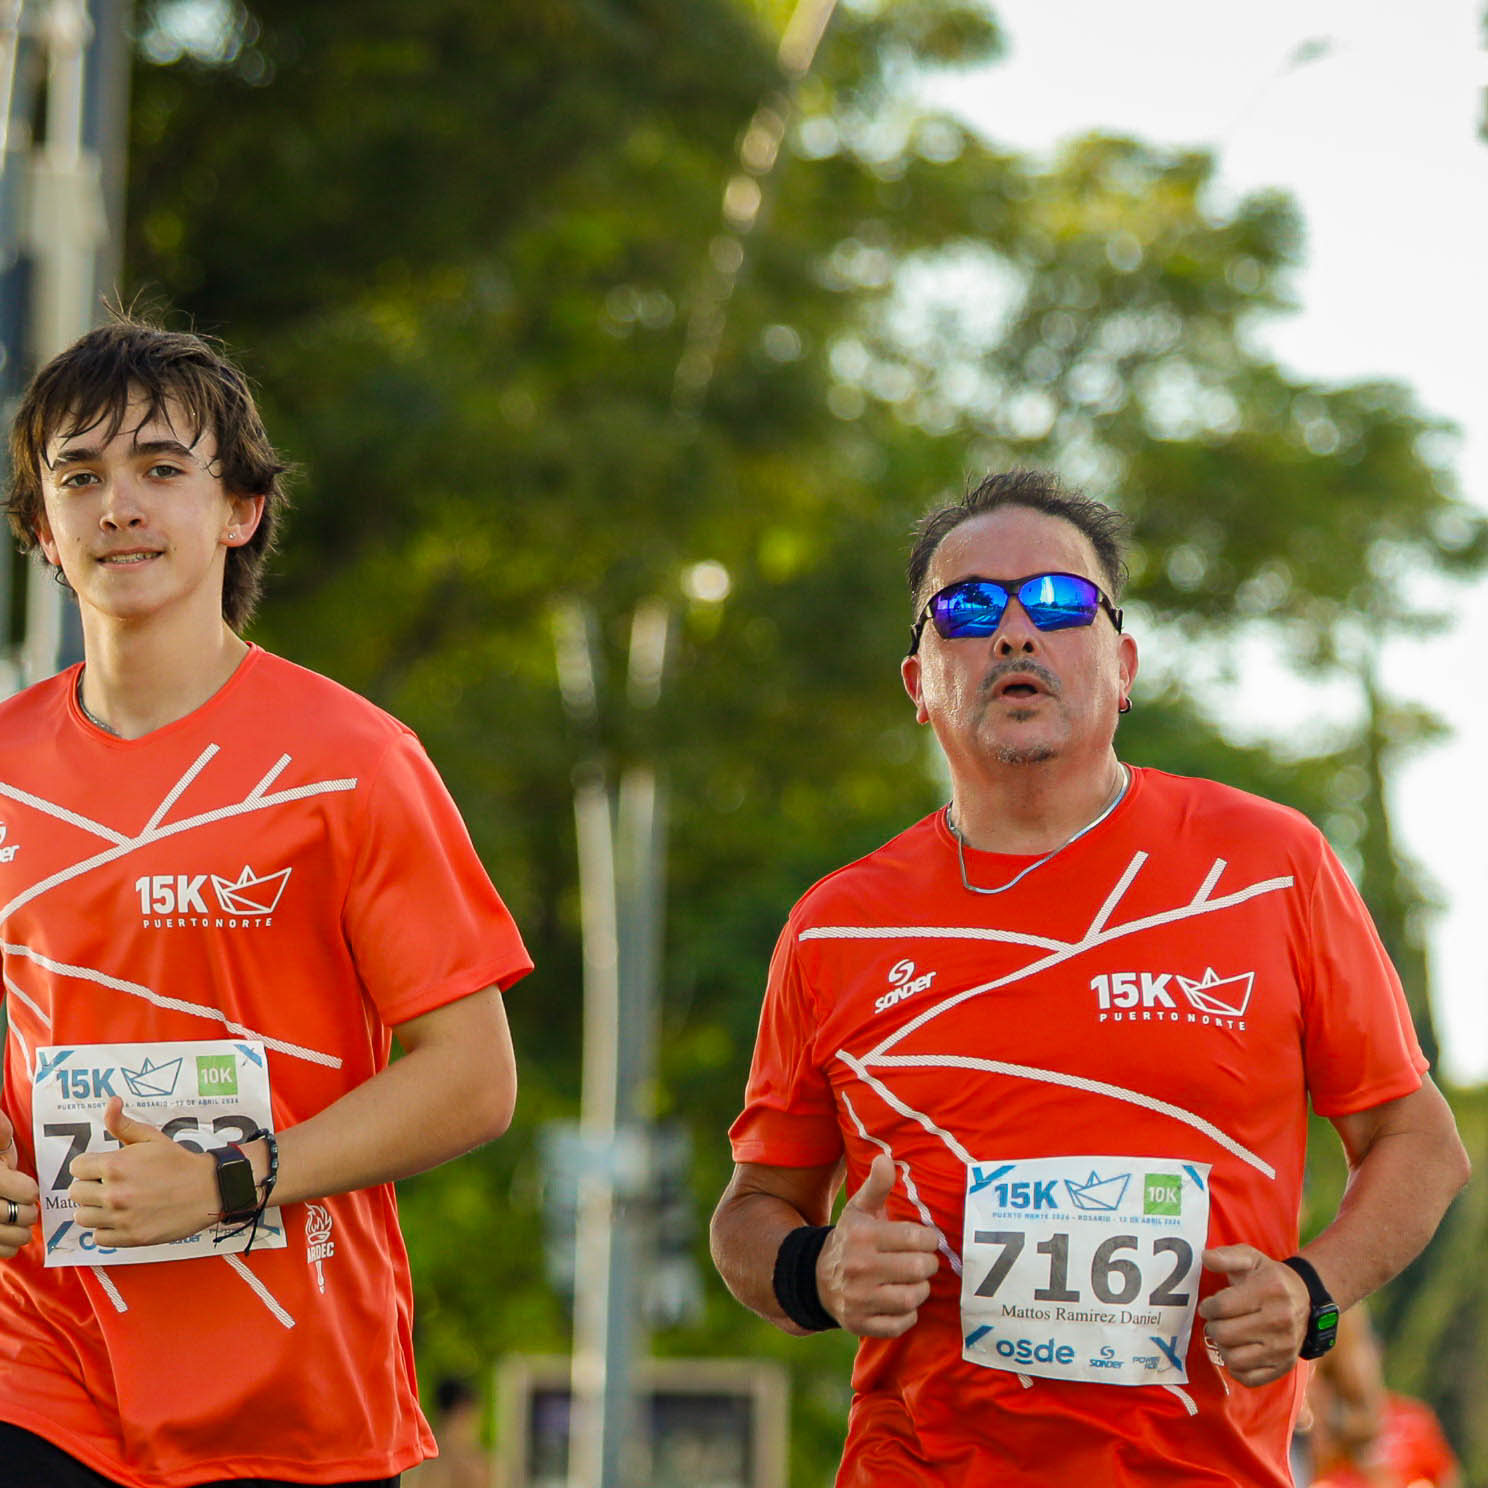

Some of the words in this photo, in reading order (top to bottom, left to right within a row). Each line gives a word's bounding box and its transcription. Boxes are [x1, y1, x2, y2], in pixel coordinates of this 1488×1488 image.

[136, 874, 209, 914] 15K
[143, 918, 209, 929] PUERTO
[216, 918, 273, 928] NORTE
[1090, 972, 1177, 1010] 15K
[1100, 1012, 1179, 1023] PUERTO
[1187, 1013, 1246, 1031] NORTE
[55, 1067, 118, 1100] 15K
[200, 1067, 234, 1084] 10K
[994, 1180, 1059, 1210] 15K
[1148, 1185, 1178, 1204] 10K
[974, 1230, 1194, 1307] 7162
[1001, 1304, 1051, 1320] Mattos
[1055, 1307, 1116, 1324] Ramirez
[1120, 1310, 1162, 1326] Daniel
[996, 1337, 1076, 1365] osde
